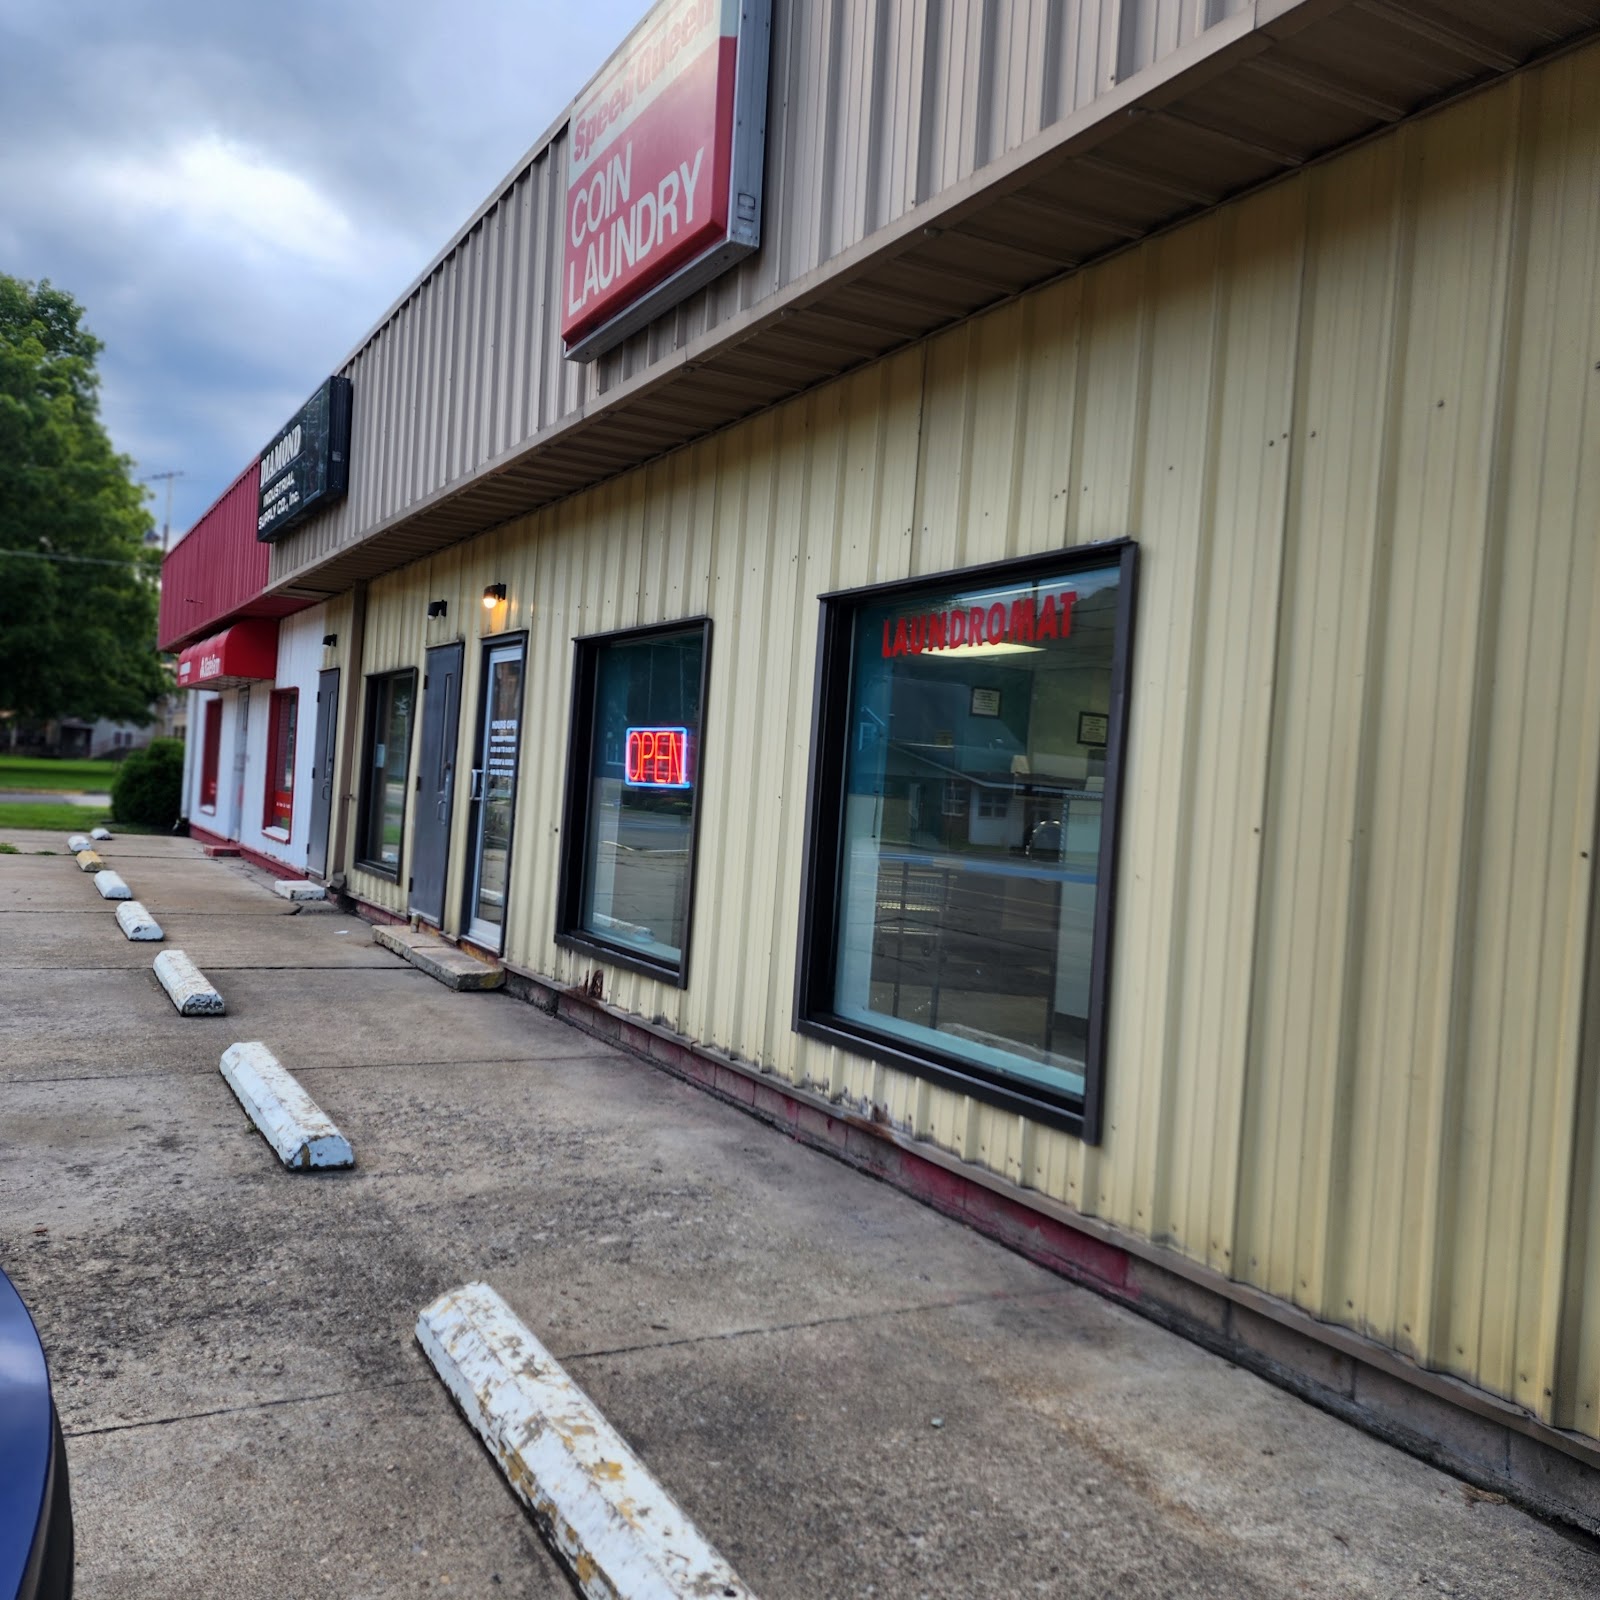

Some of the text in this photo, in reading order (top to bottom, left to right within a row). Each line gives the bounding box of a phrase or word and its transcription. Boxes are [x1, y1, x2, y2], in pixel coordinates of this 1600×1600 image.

[573, 0, 715, 162] Speed Queen
[571, 141, 633, 248] COIN
[567, 146, 705, 318] LAUNDRY
[260, 424, 302, 488] DIAMOND
[258, 502, 277, 531] SUPPLY
[263, 471, 296, 508] INDUSTRIAL
[881, 591, 1078, 659] LAUNDROMAT
[628, 731, 685, 784] OPEN
